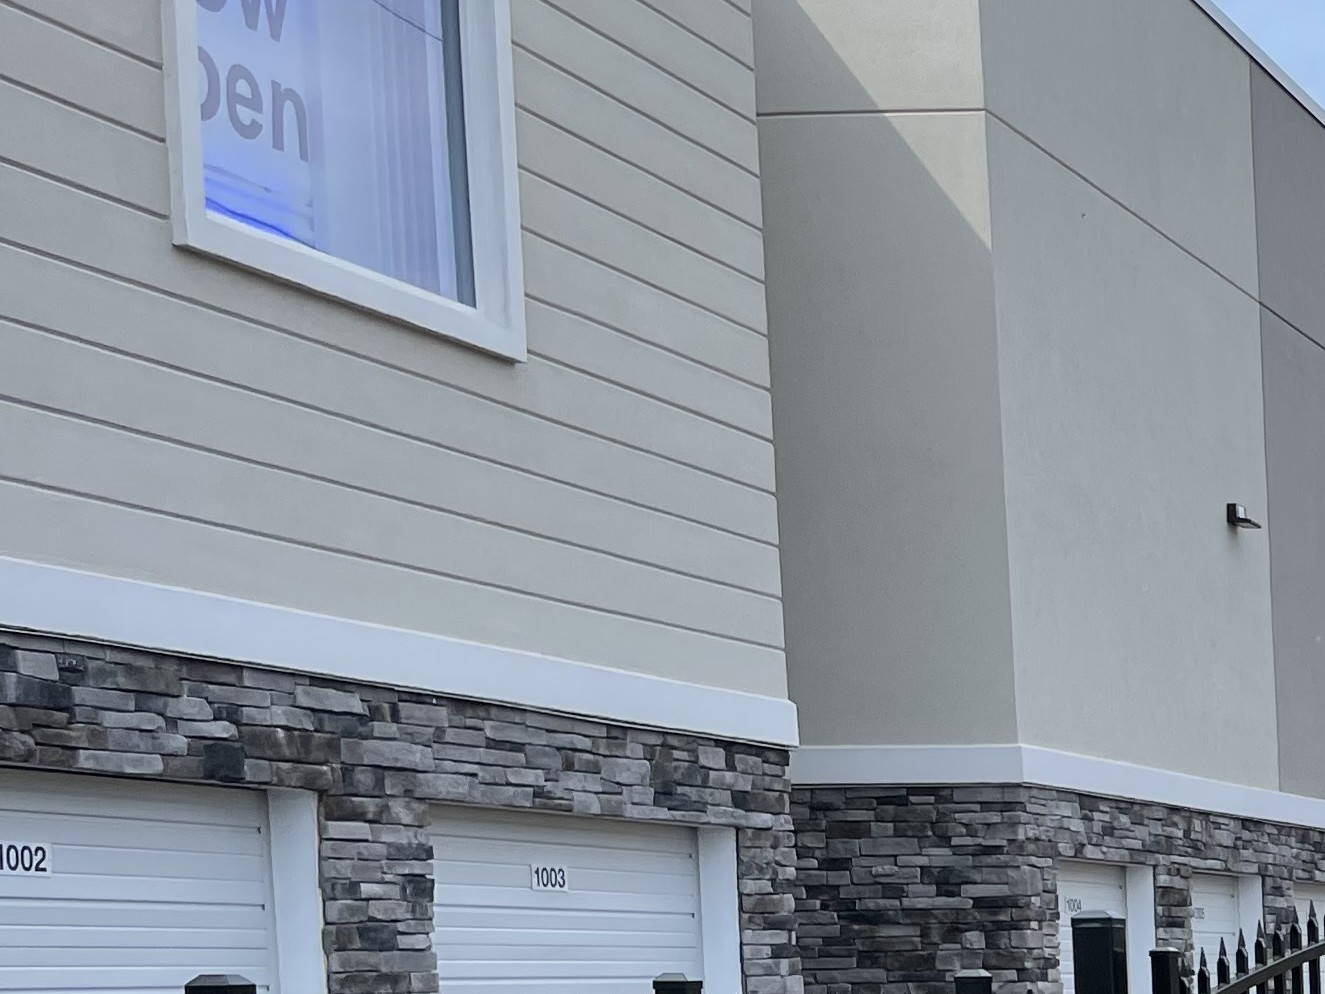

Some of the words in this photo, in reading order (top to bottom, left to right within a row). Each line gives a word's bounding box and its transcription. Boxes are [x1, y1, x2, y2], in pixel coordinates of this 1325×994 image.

[196, 0, 287, 42] w
[0, 844, 47, 872] 1002
[534, 867, 566, 888] 1003
